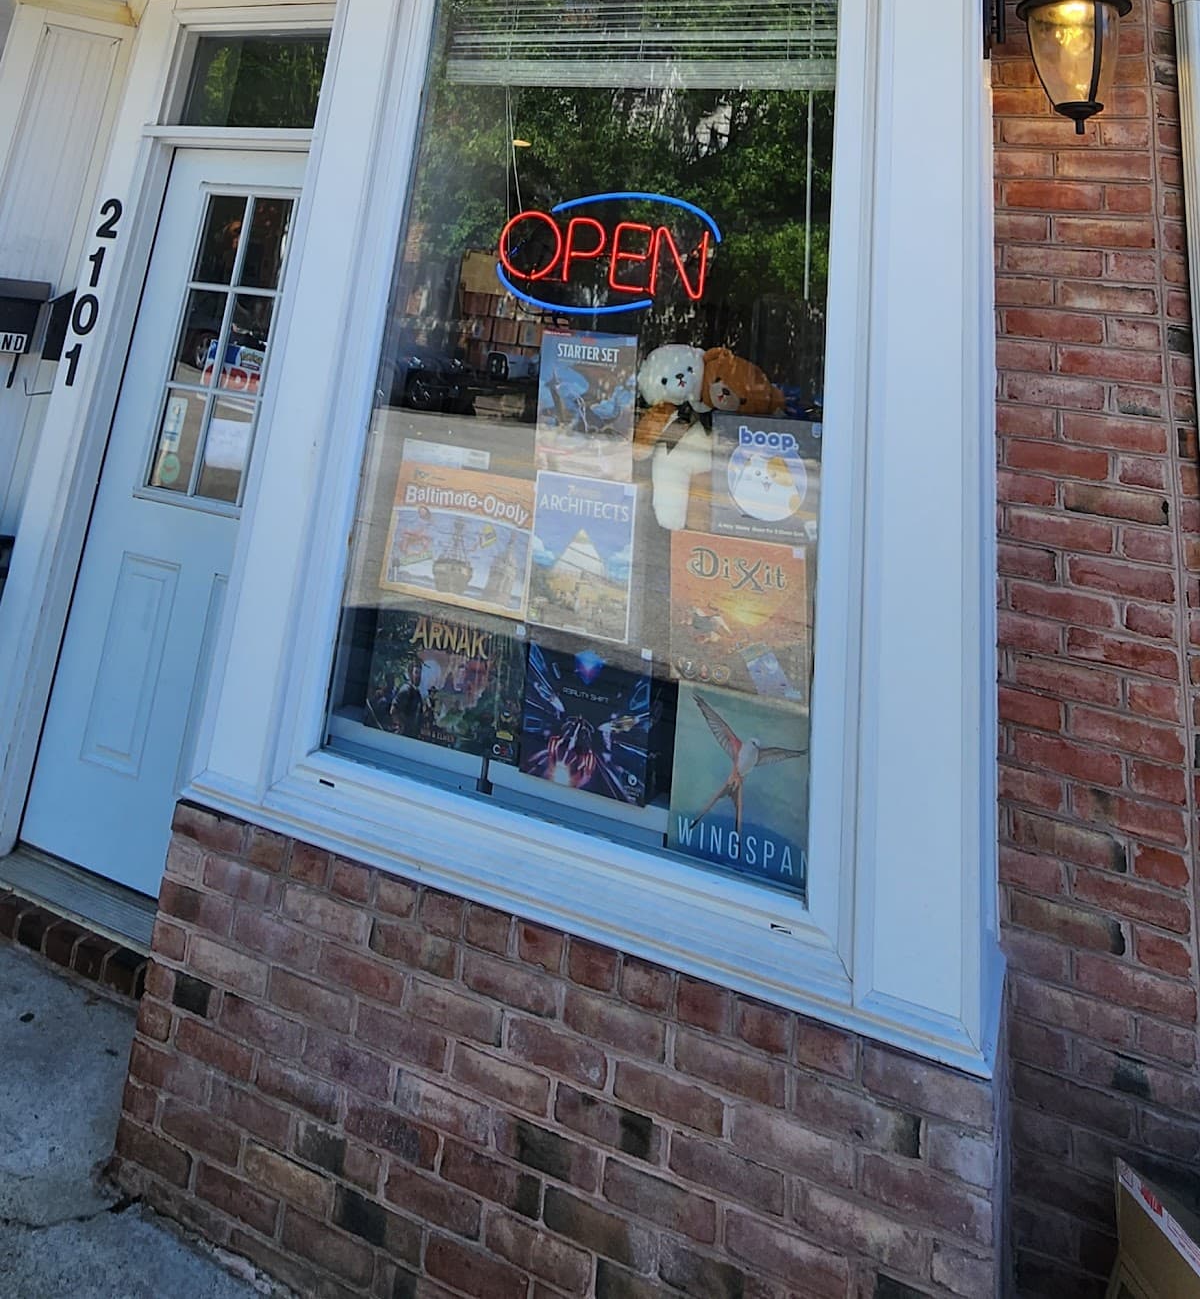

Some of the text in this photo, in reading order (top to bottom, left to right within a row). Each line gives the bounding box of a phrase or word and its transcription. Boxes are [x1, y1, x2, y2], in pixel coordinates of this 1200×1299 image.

[500, 211, 709, 299] OPEN
[65, 198, 123, 387] 2101
[556, 343, 620, 363] STARTER SET
[405, 484, 529, 525] Baltimore-Opoly
[539, 493, 630, 523] ARCHITECTS
[408, 616, 489, 661] ARNAK
